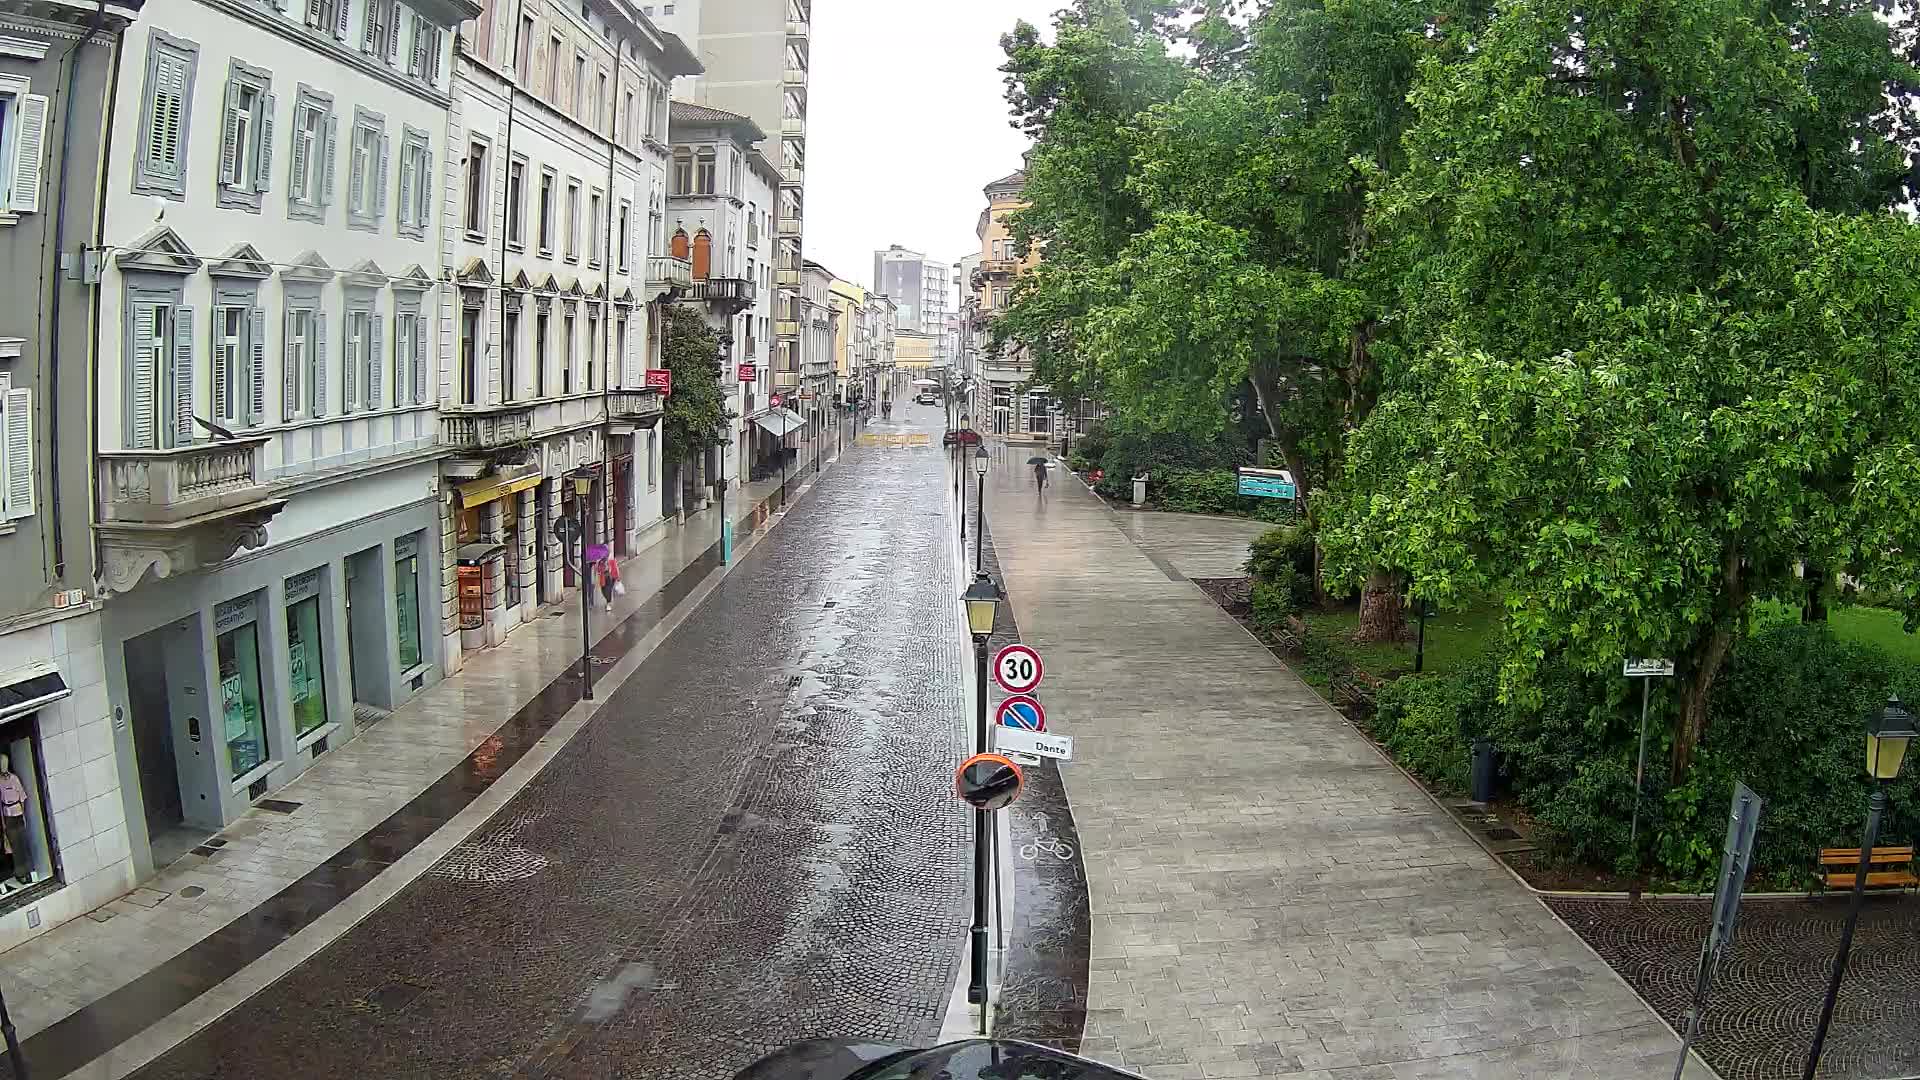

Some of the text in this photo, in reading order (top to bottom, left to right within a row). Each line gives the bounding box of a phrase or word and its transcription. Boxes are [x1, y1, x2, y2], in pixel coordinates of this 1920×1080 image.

[1005, 658, 1033, 680] 30
[222, 677, 241, 701] 130
[1035, 742, 1066, 755] Dante
